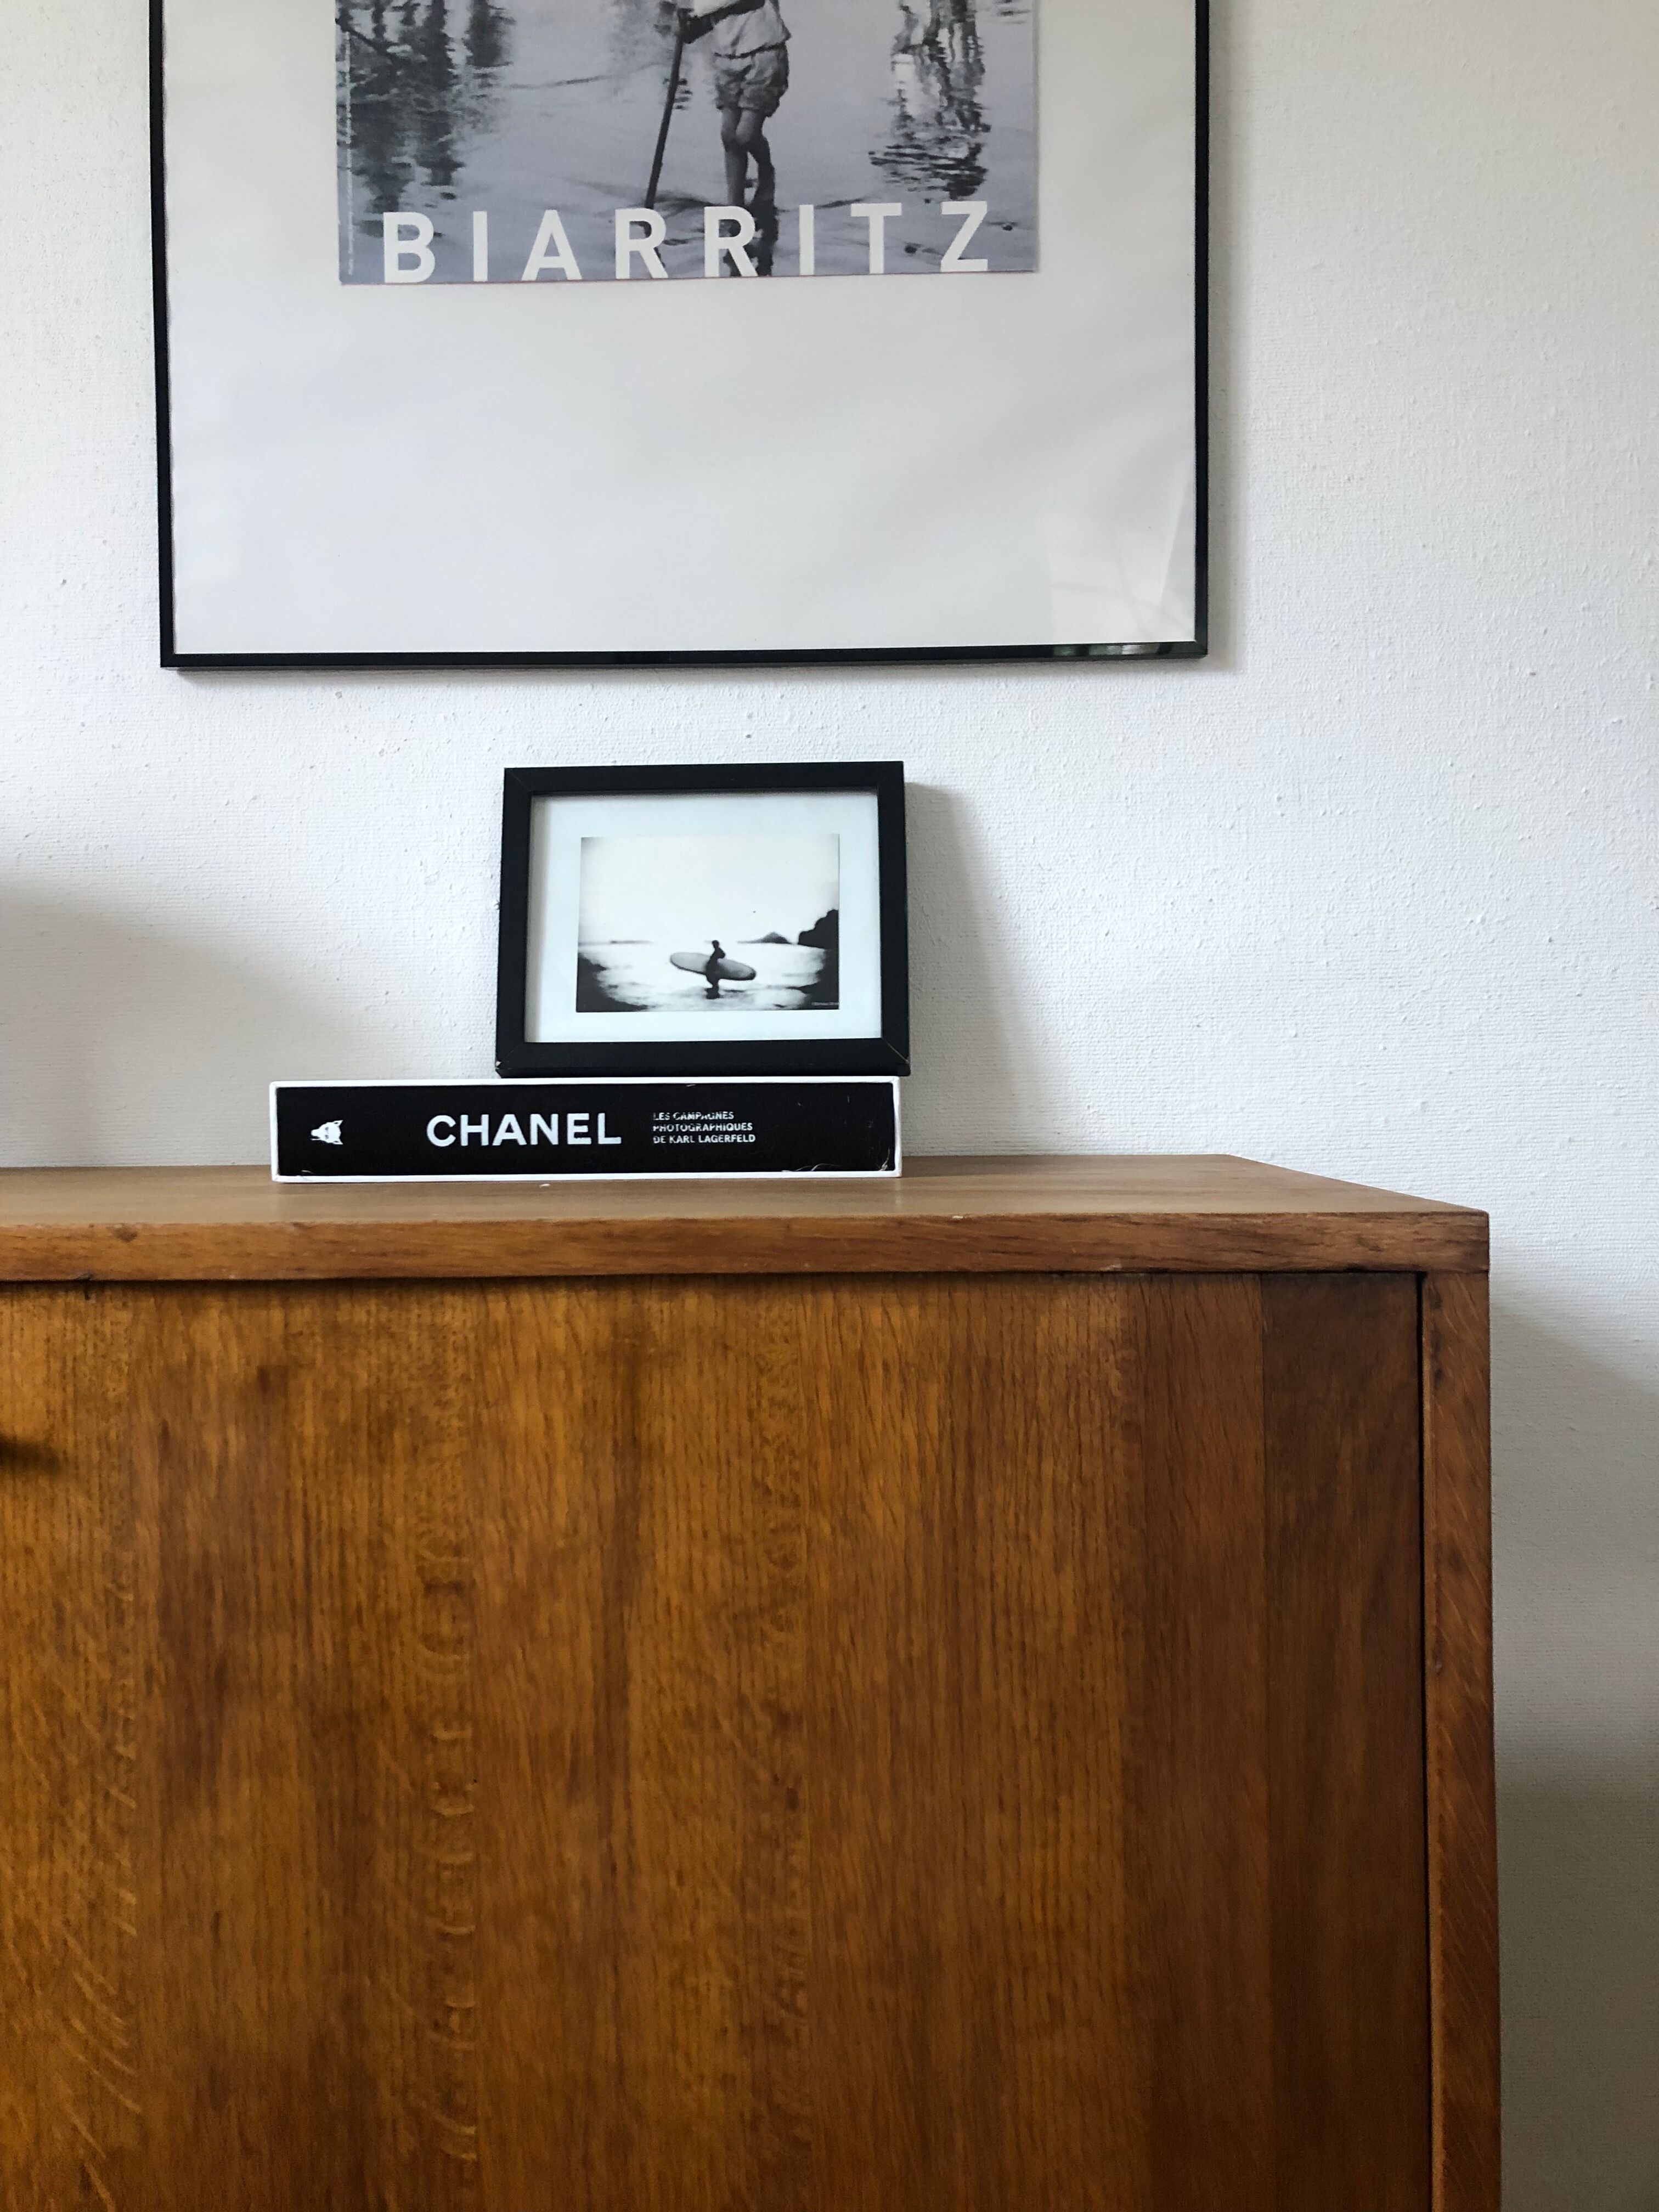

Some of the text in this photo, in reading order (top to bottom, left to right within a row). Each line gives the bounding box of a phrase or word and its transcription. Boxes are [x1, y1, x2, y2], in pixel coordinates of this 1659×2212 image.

[383, 201, 988, 283] BIARRITZ
[653, 1112, 670, 1121] LES
[427, 1113, 621, 1147] CHANEL
[653, 1122, 753, 1132] PHOTOGRAPHIQUES
[653, 1134, 755, 1144] DE KARL LAGERFELD
